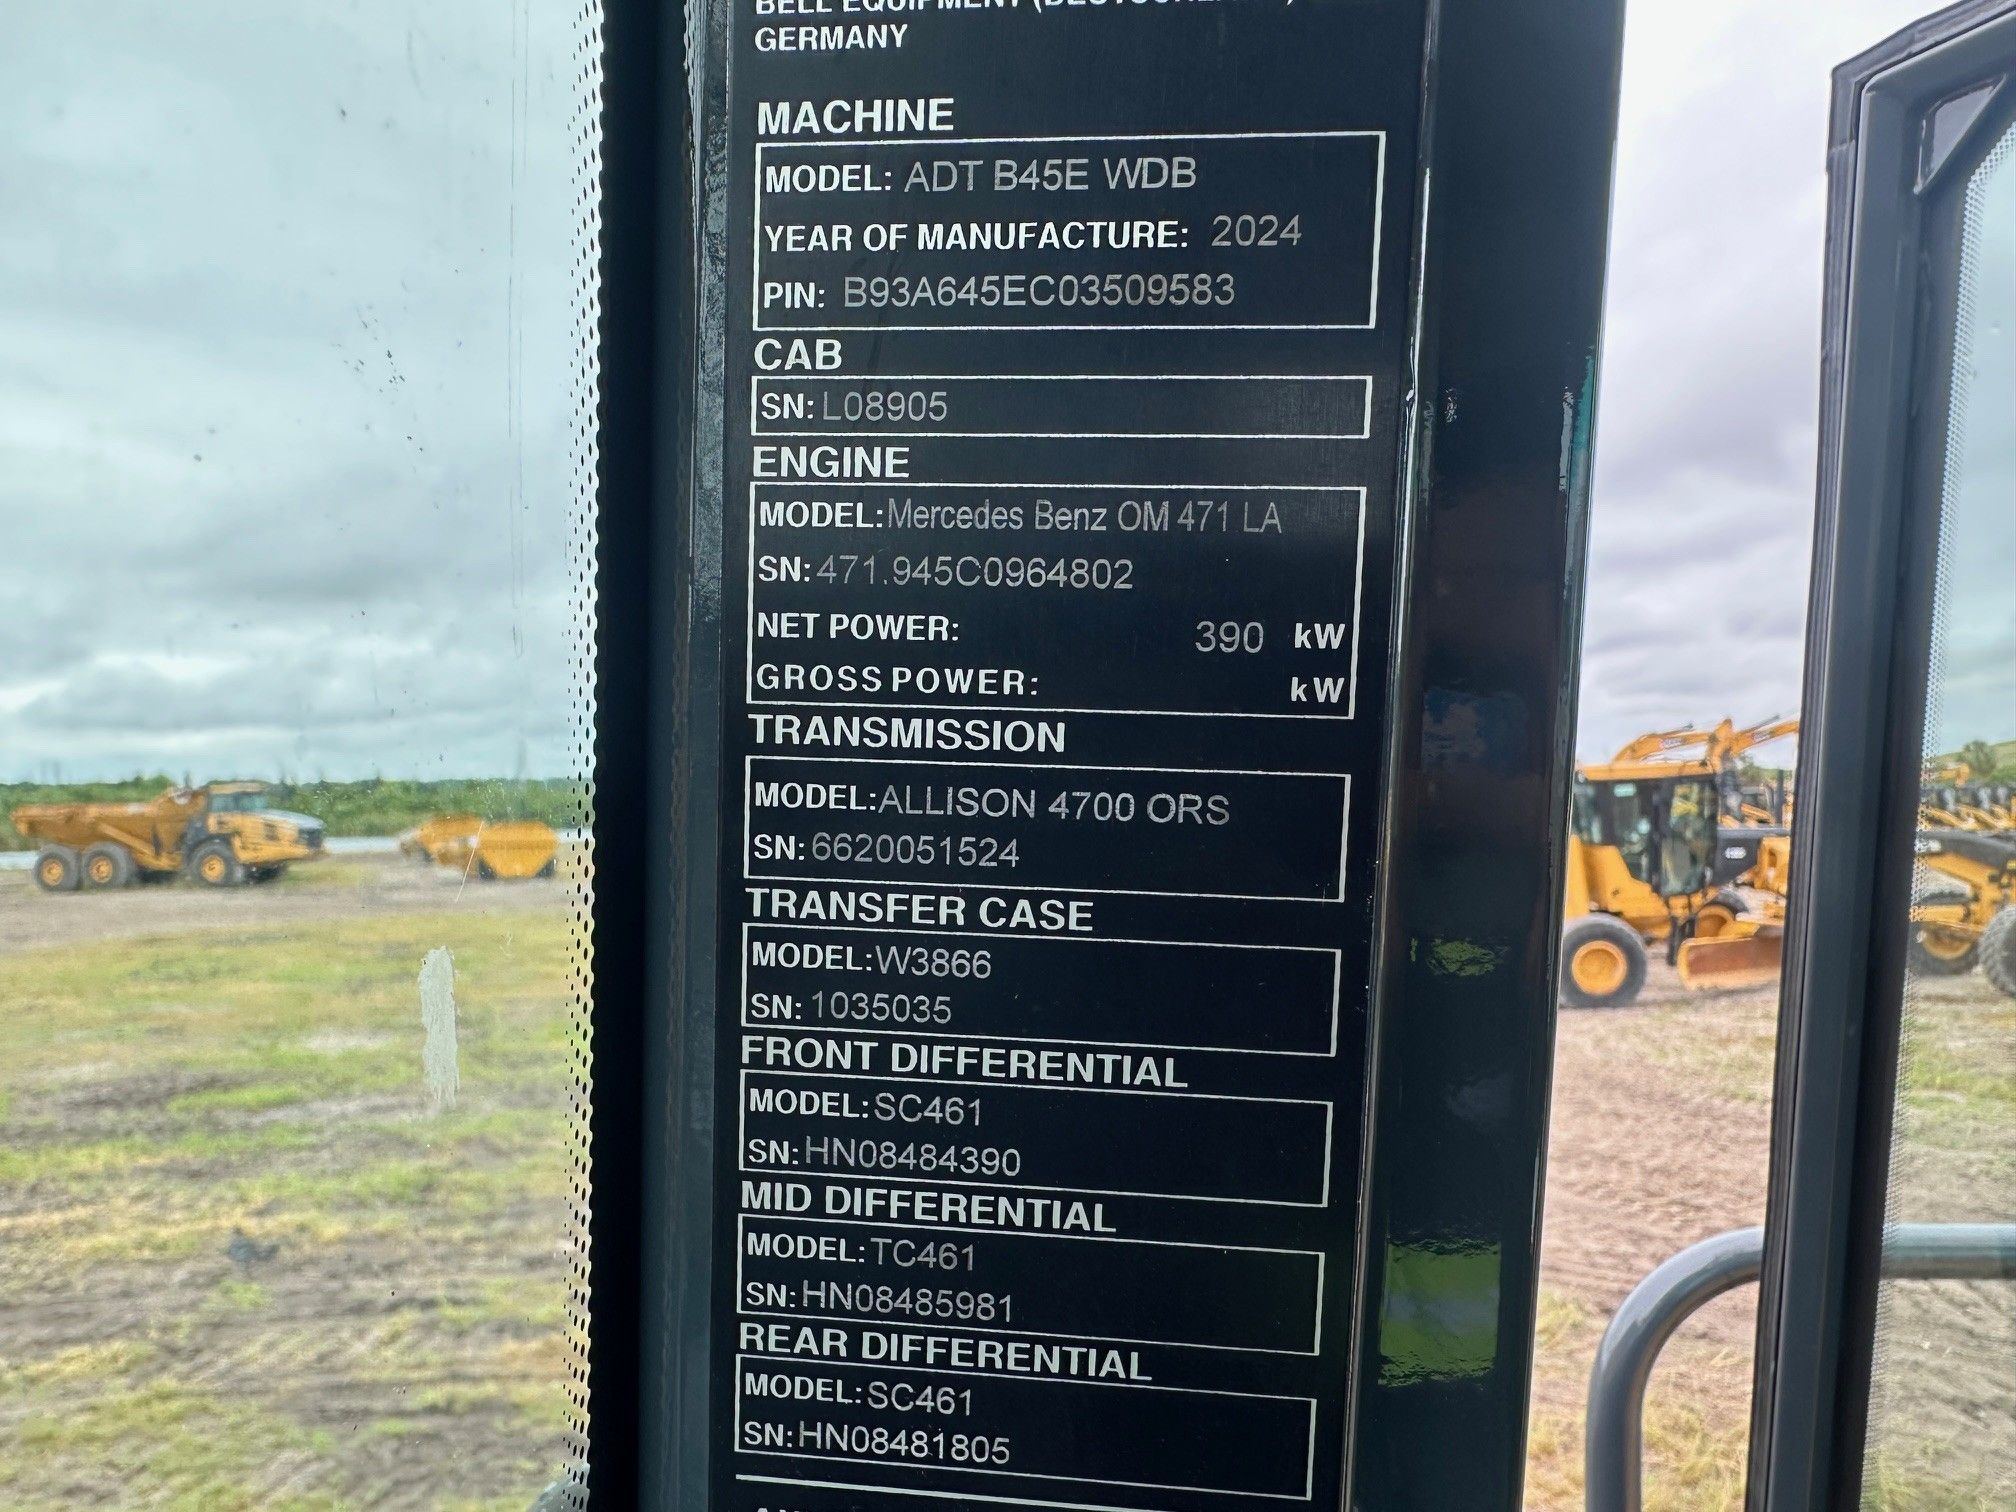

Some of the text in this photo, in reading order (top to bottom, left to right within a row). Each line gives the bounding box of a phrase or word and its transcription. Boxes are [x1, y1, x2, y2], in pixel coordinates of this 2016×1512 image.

[755, 0, 833, 15] BELL
[754, 23, 909, 53] GERMANY
[757, 97, 956, 136] MACHINE
[765, 156, 1198, 194] MODEL: ADT B45E WDB
[764, 214, 1303, 253] YEAR OF MANUFACTURE: 2024
[763, 272, 1236, 309] PIN: B93A645EC03509583
[753, 337, 843, 371] CAB
[760, 390, 948, 422] SN: L08905
[752, 445, 911, 479] ENGINE
[759, 497, 1283, 534] MODEL: Mercedes Benz OM 471 LA
[758, 554, 1135, 591] SN: 471.945C0964802
[757, 611, 1346, 654] NET POWER: 390 kW
[756, 662, 1346, 704] GROSS POWER: kW
[747, 713, 1067, 753] TRANSMISSION
[754, 781, 1231, 826] MODEL: ALLISON 4700 ORS
[753, 831, 1020, 868] SN: 6620051524
[744, 887, 1094, 932] TRANSFER CASE
[752, 941, 992, 980] MODEL: W3866
[750, 990, 953, 1025] SN: 1035035
[741, 1034, 1189, 1089] FRONT DIFFERENTIAL
[749, 1087, 982, 1127] MODEL: SC461
[748, 1135, 1022, 1177] SN: HN08484390
[741, 1180, 1117, 1233] MID DIFFERENTIAL
[747, 1231, 976, 1271] MODEL: TC461
[745, 1279, 1014, 1323] SN: HN08485981
[739, 1321, 1153, 1382] REAR DIFFERENTIAL
[745, 1371, 974, 1417] MODEL: SC461
[743, 1420, 1011, 1465] SN: HN08481805
